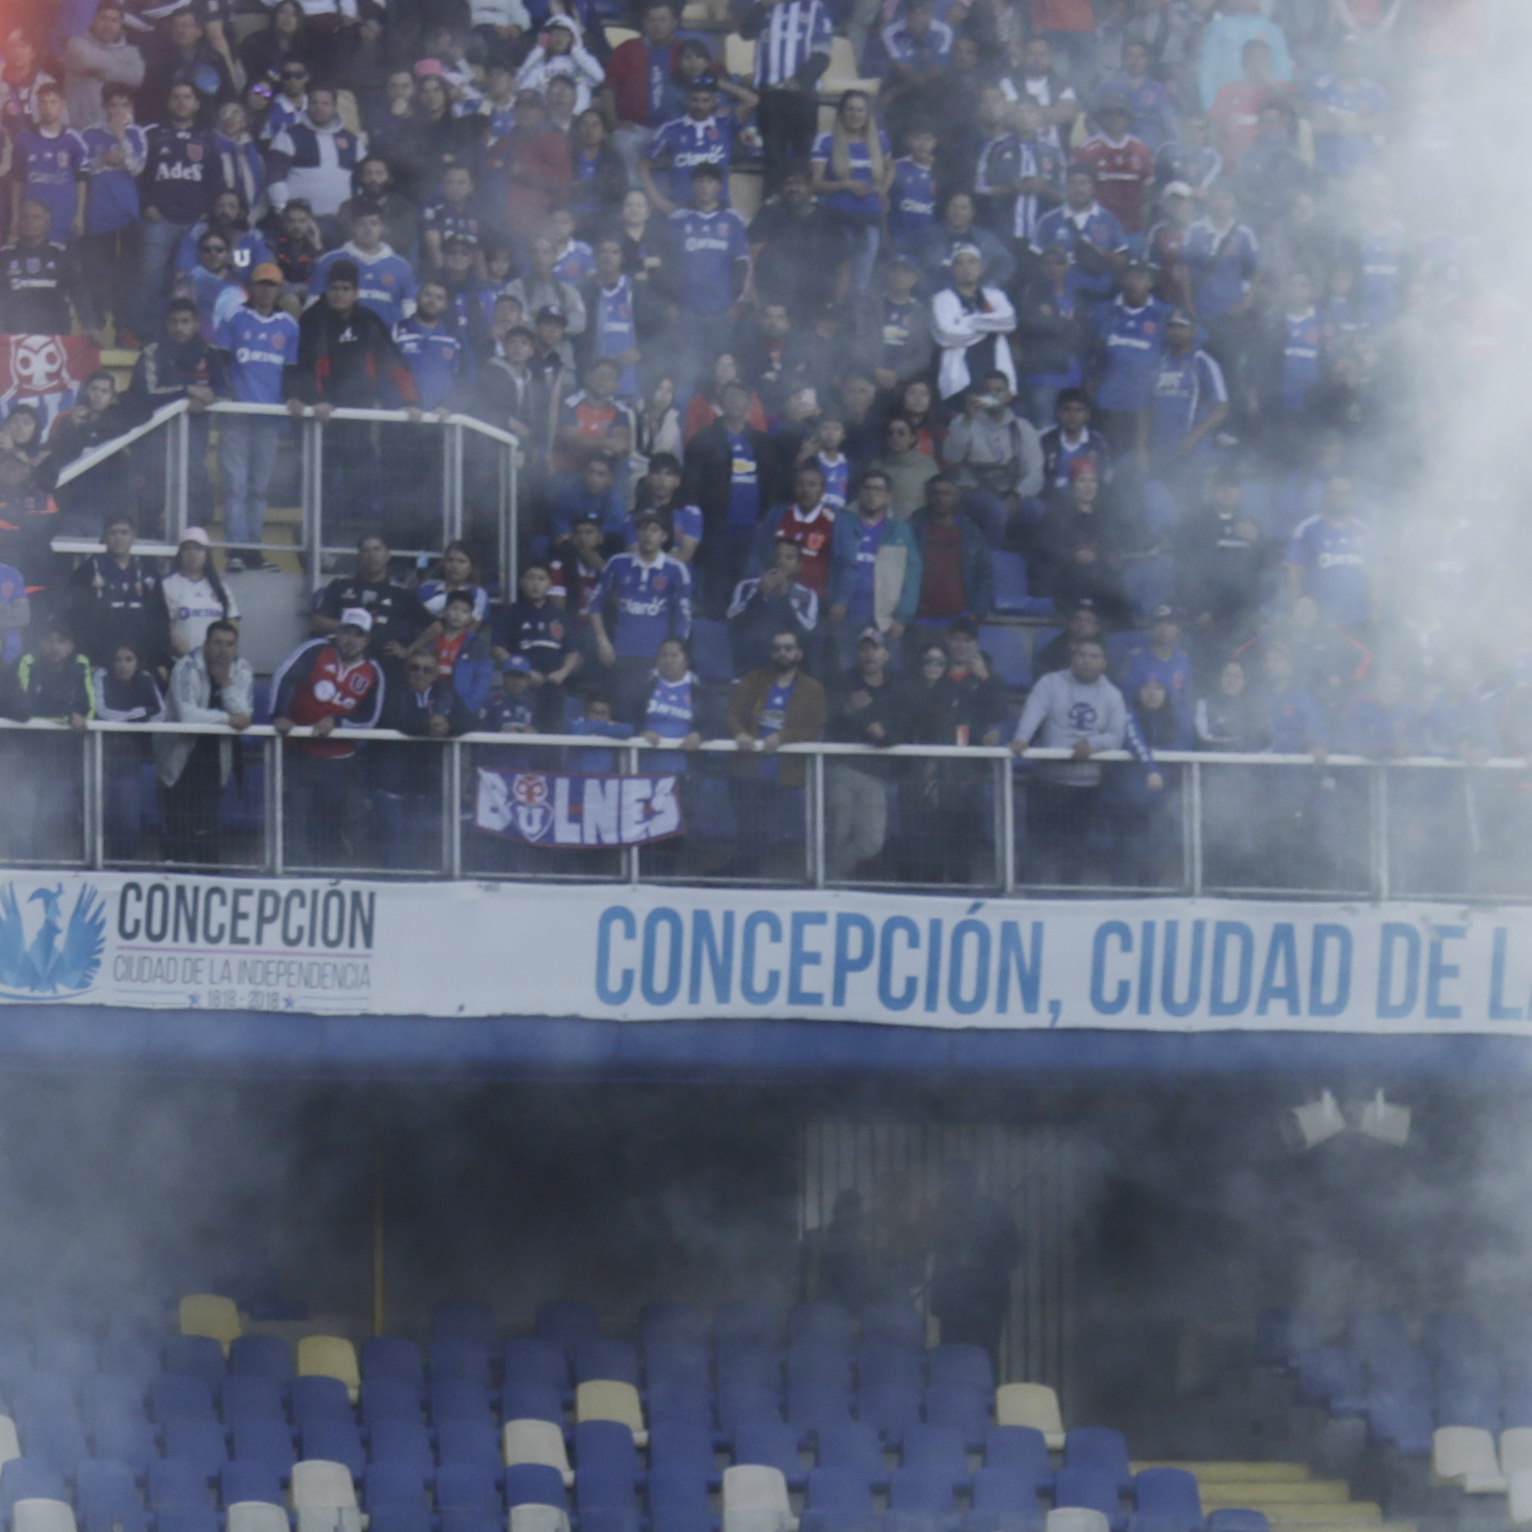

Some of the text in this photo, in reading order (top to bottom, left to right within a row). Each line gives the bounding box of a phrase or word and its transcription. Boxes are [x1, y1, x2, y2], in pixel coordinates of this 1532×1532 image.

[155, 162, 202, 182] AdeS
[117, 879, 376, 949] CONCEPCIÓN
[113, 955, 371, 990] CIUDAD DE LA INDEPENDENCIA
[596, 902, 1063, 1027] CONCEPCIÓN,
[1091, 918, 1353, 1019] CIUDAD
[1375, 921, 1467, 1020] DE
